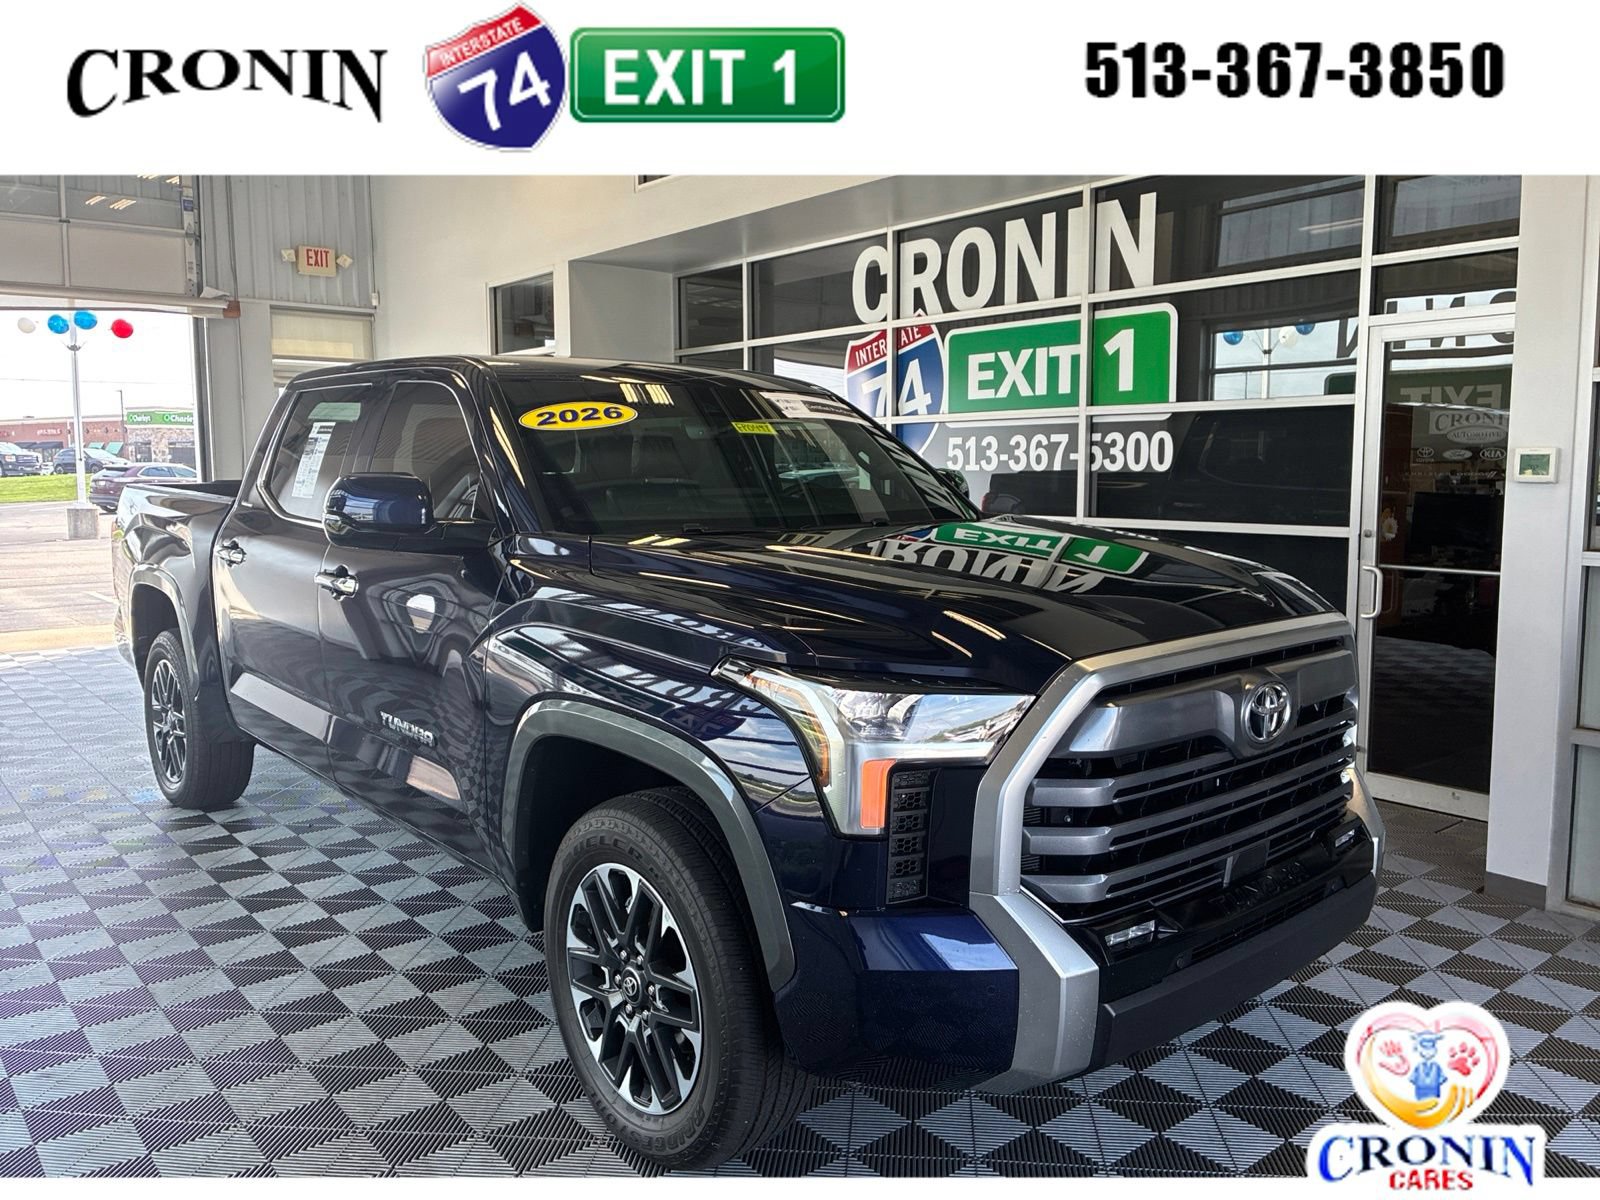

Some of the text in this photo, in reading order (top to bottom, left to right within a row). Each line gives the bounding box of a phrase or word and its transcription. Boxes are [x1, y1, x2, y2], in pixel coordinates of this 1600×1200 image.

[306, 249, 329, 268] EXIT
[852, 192, 1157, 324] CRONIN
[856, 324, 921, 367] INTERATE
[967, 328, 1134, 400] EXIT 1
[536, 406, 623, 426] 2026
[1435, 410, 1509, 432] CRONI
[946, 430, 1174, 472] 513-367-5300
[1484, 449, 1502, 458] KIA
[380, 710, 434, 747] TUNDRA
